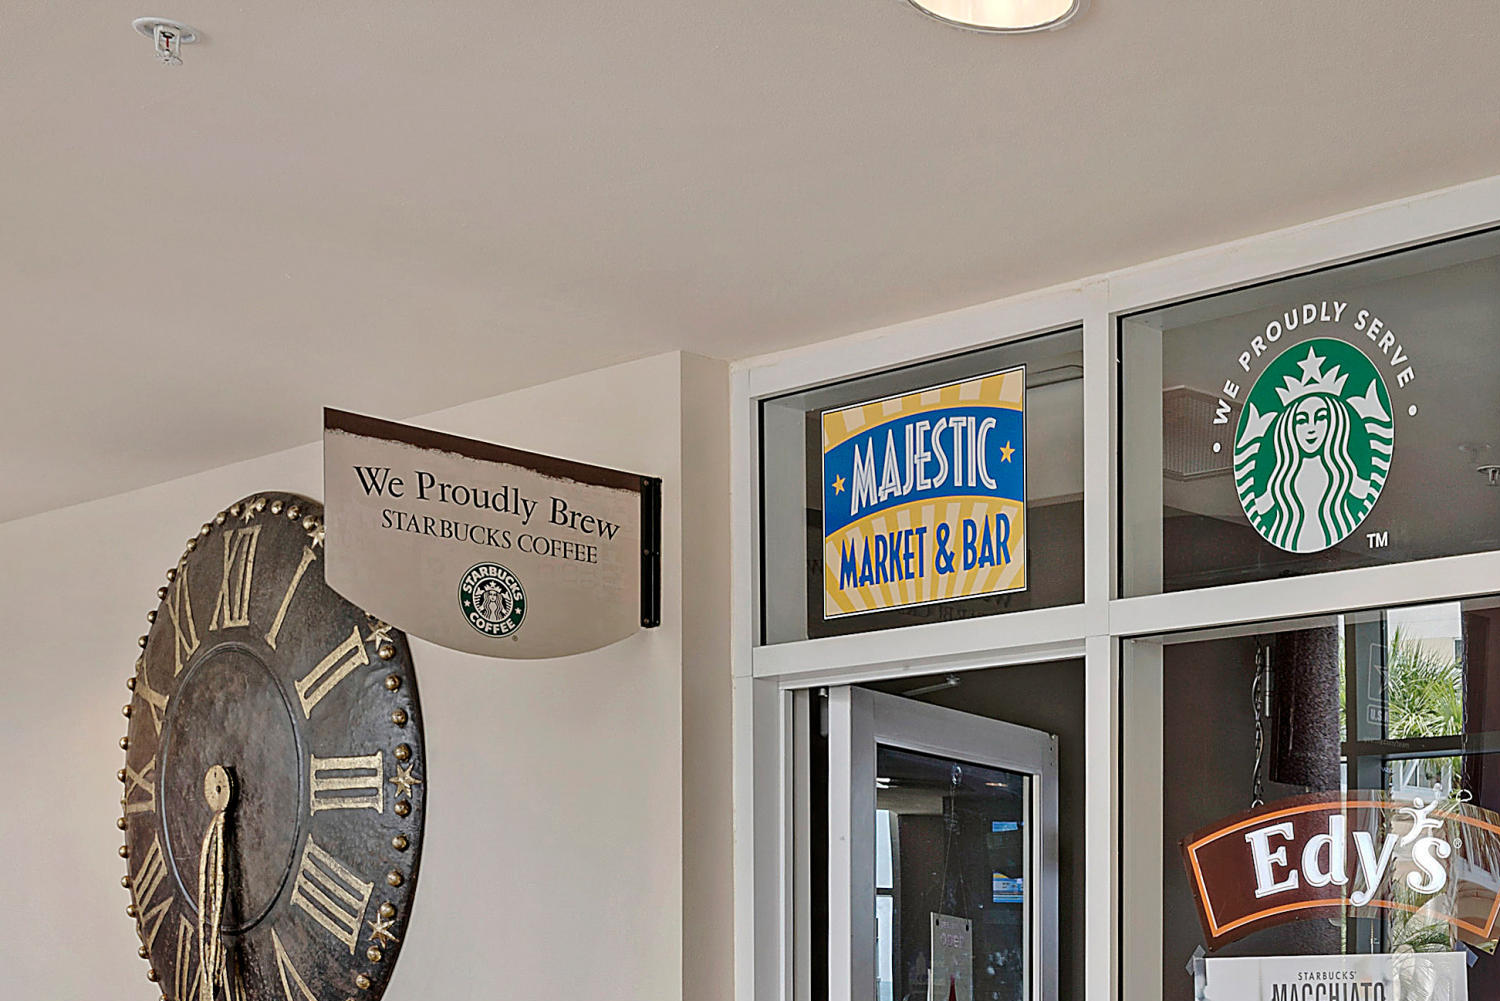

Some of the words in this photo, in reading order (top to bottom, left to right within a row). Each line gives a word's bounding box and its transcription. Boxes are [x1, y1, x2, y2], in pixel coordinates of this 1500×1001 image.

[1212, 379, 1241, 425] WE
[1238, 300, 1348, 373] PROUDLY
[1353, 309, 1416, 389] SERVE
[850, 415, 999, 517] MAJESTIC
[353, 465, 405, 499] We
[414, 470, 539, 526] Proudly
[548, 496, 622, 542] Brew
[381, 508, 512, 550] STARBUCKS
[517, 534, 599, 565] COFFEE
[839, 526, 928, 591] MARKET
[934, 522, 956, 576] &
[962, 512, 1012, 572] BAR
[1366, 531, 1389, 549] TM
[462, 566, 523, 602] STARBUCKS
[469, 612, 516, 635] COFFEE
[1243, 797, 1453, 908] Edy's
[1297, 971, 1356, 981] STARBUCKS
